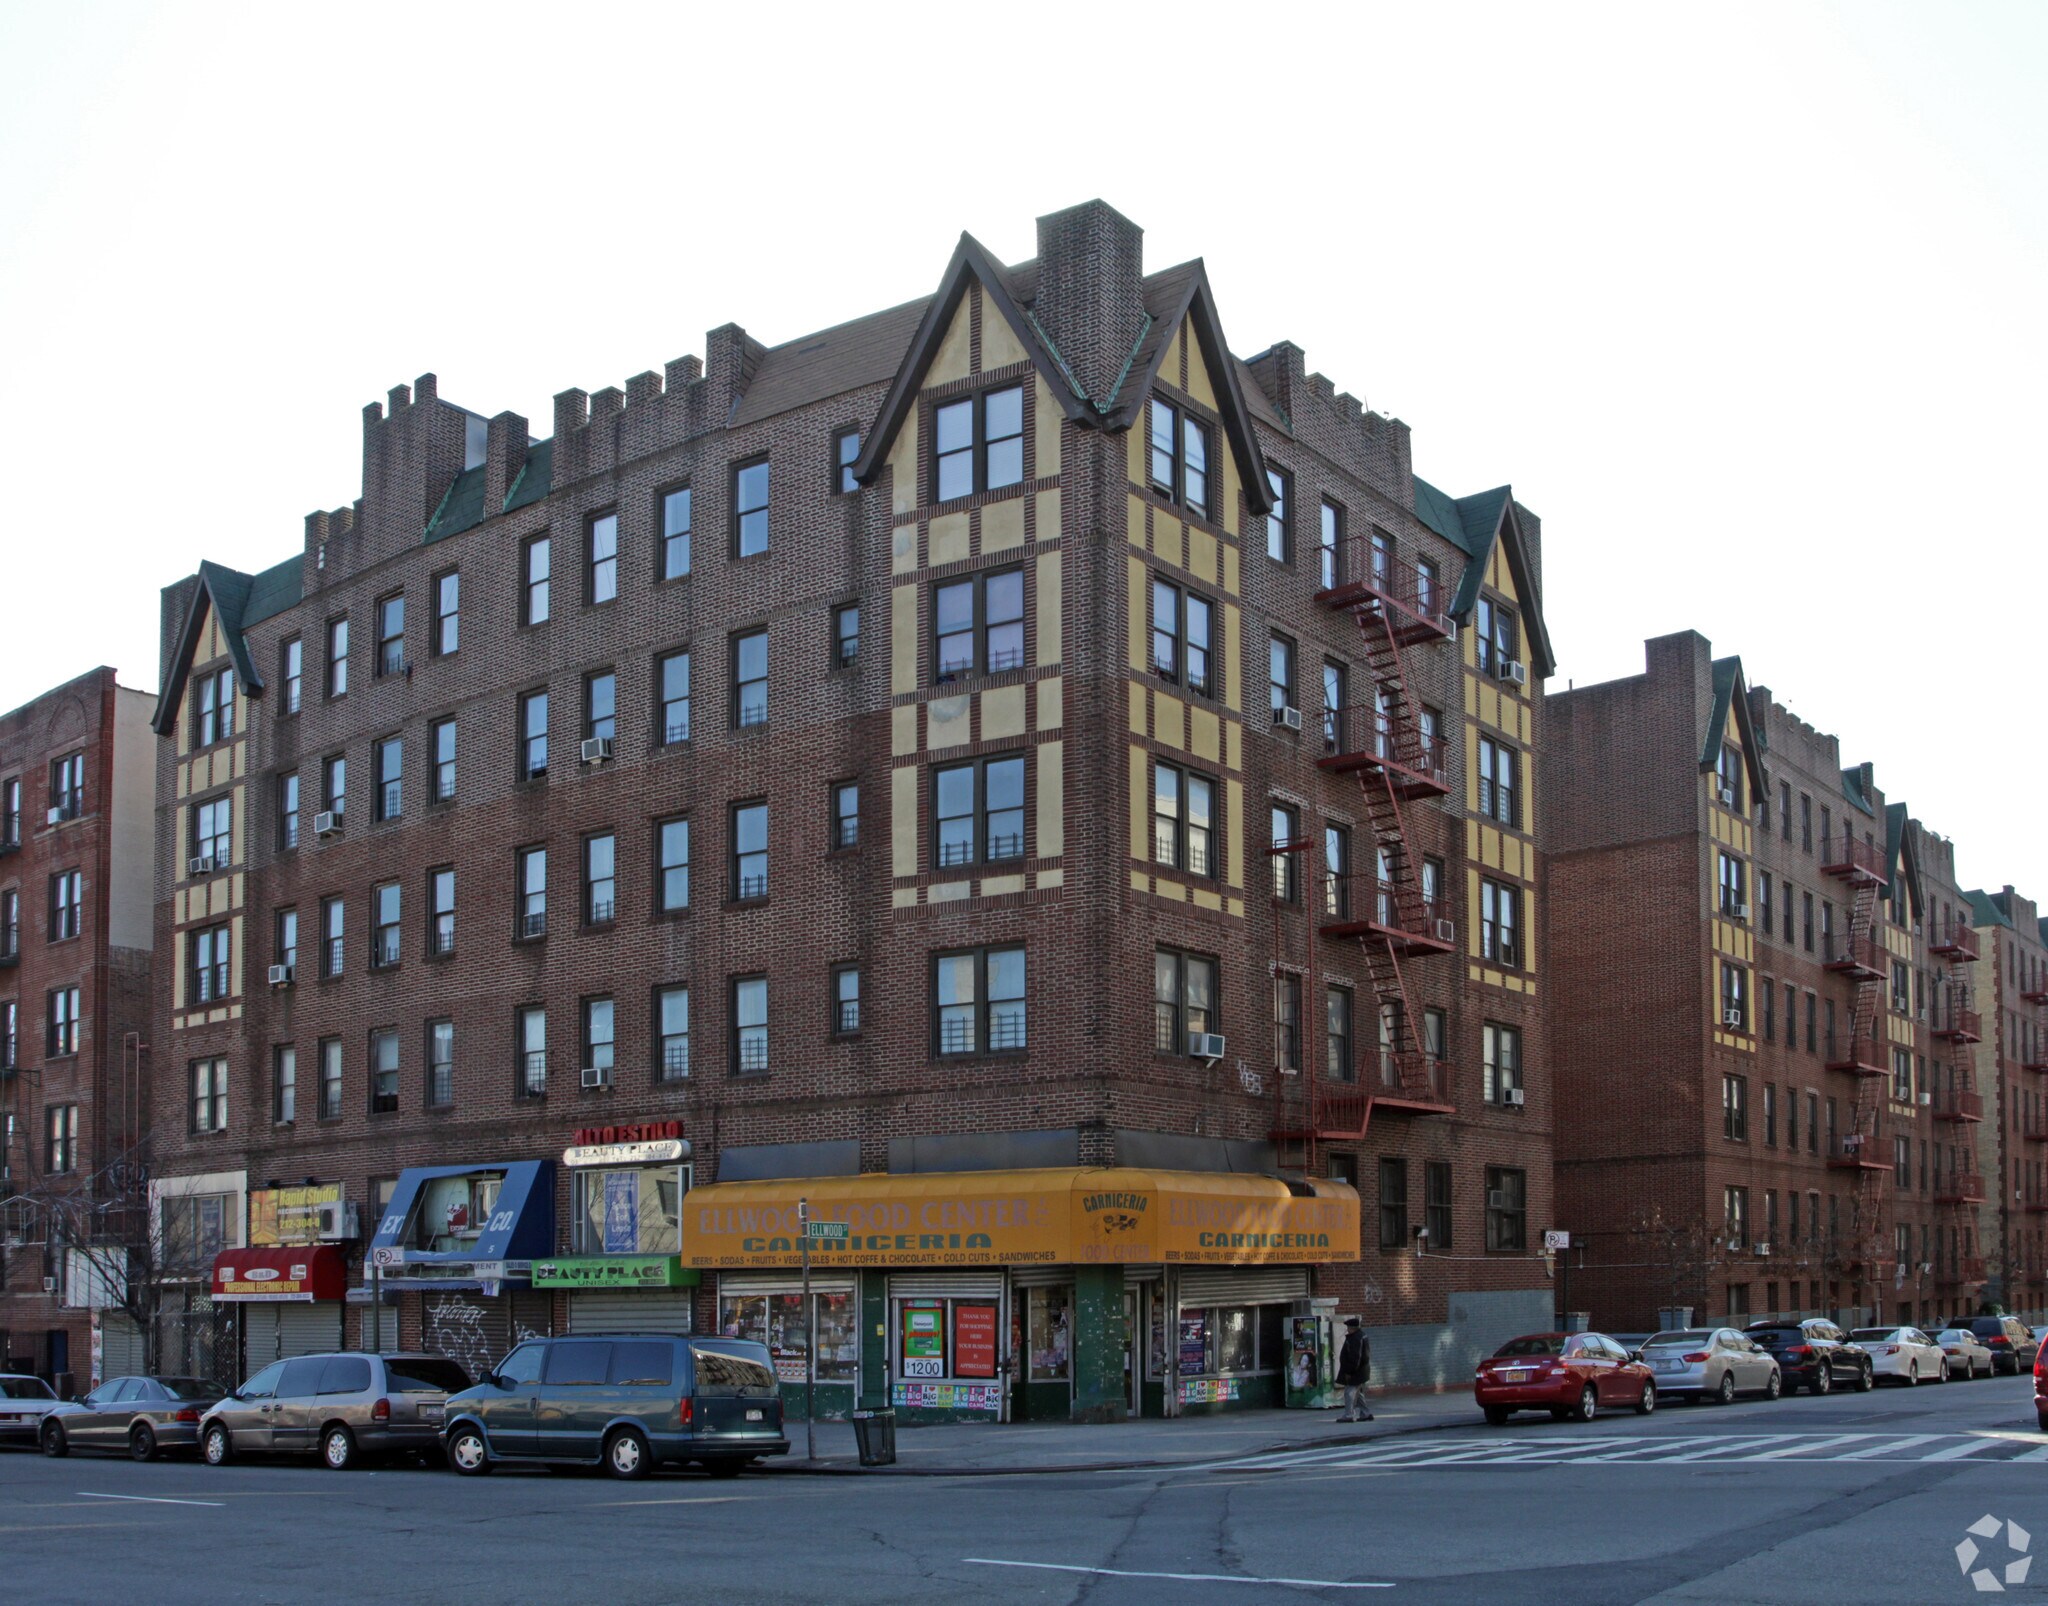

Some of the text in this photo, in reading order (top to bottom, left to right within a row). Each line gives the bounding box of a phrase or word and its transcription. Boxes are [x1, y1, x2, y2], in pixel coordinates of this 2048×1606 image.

[573, 1121, 682, 1145] ALTO ESTILO
[574, 1142, 673, 1158] BEAUTY PLACE
[279, 1186, 338, 1207] Rapid Studio
[1083, 1192, 1148, 1212] CARNICERIA
[490, 1211, 514, 1232] CO.
[700, 1199, 1030, 1235] ELLWOOD FOOD CENTER
[1170, 1198, 1247, 1229] ELLWOOD
[1250, 1201, 1292, 1229] FOOD
[1295, 1202, 1344, 1230] CENTER
[811, 1224, 843, 1237] ELLWOOD
[743, 1233, 992, 1252] CARNICERIA
[1199, 1232, 1329, 1248] CARNICERIA
[691, 1251, 1056, 1265] BEERS SODAS FRUITS VEGEABLES HOT COFFE & CHOCOLATE COLD CUTS SANDWICHES
[1080, 1244, 1151, 1260] FOOD CENTER
[1165, 1251, 1180, 1260] BEERS
[1184, 1251, 1200, 1260] SODAS
[1204, 1251, 1220, 1260] FRUITS
[1281, 1251, 1304, 1260] CHOCOLATE
[1307, 1251, 1318, 1260] COLD
[224, 1280, 300, 1293] PROFESSIONAL ELECTRONIC REPAIR
